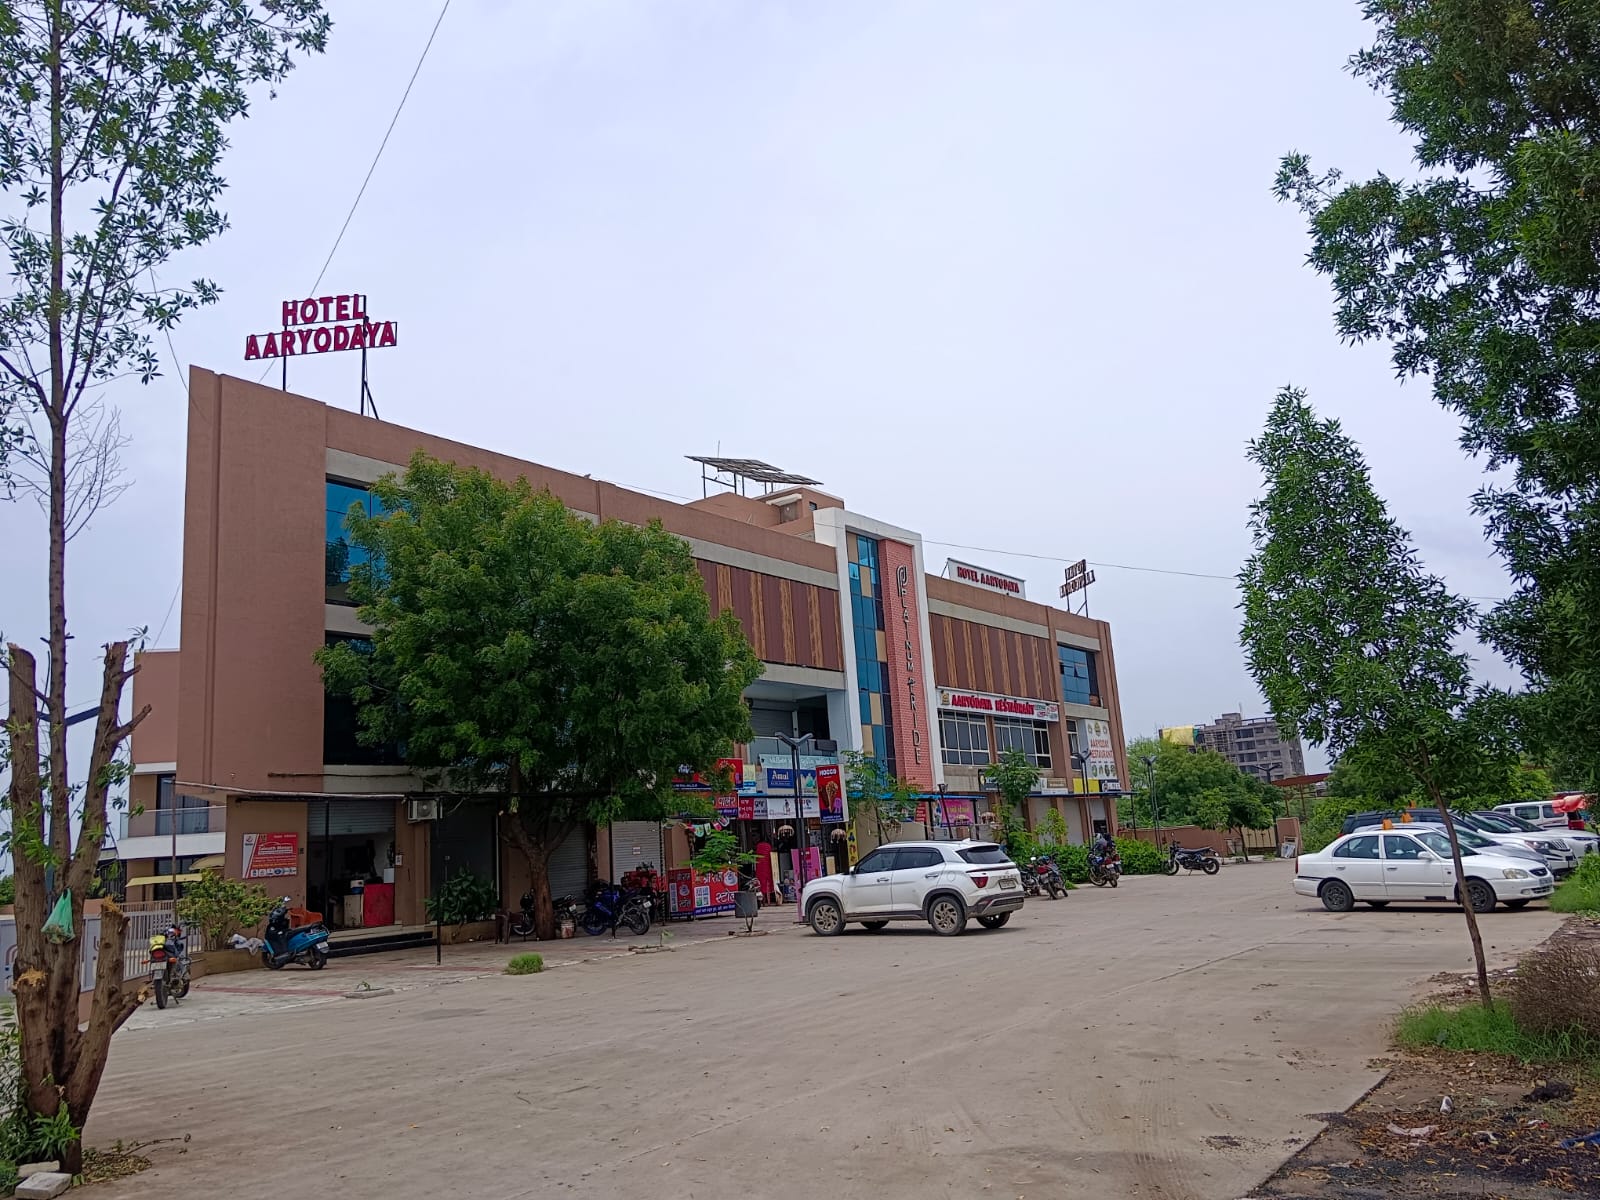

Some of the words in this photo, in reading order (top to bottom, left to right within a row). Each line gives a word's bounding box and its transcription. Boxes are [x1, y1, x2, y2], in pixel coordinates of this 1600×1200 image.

[282, 294, 365, 327] HOTEL
[244, 321, 396, 360] AARYODAYA
[957, 566, 979, 583] HOTEL
[901, 588, 915, 672] PLATINUM
[907, 676, 921, 765] PRIDE
